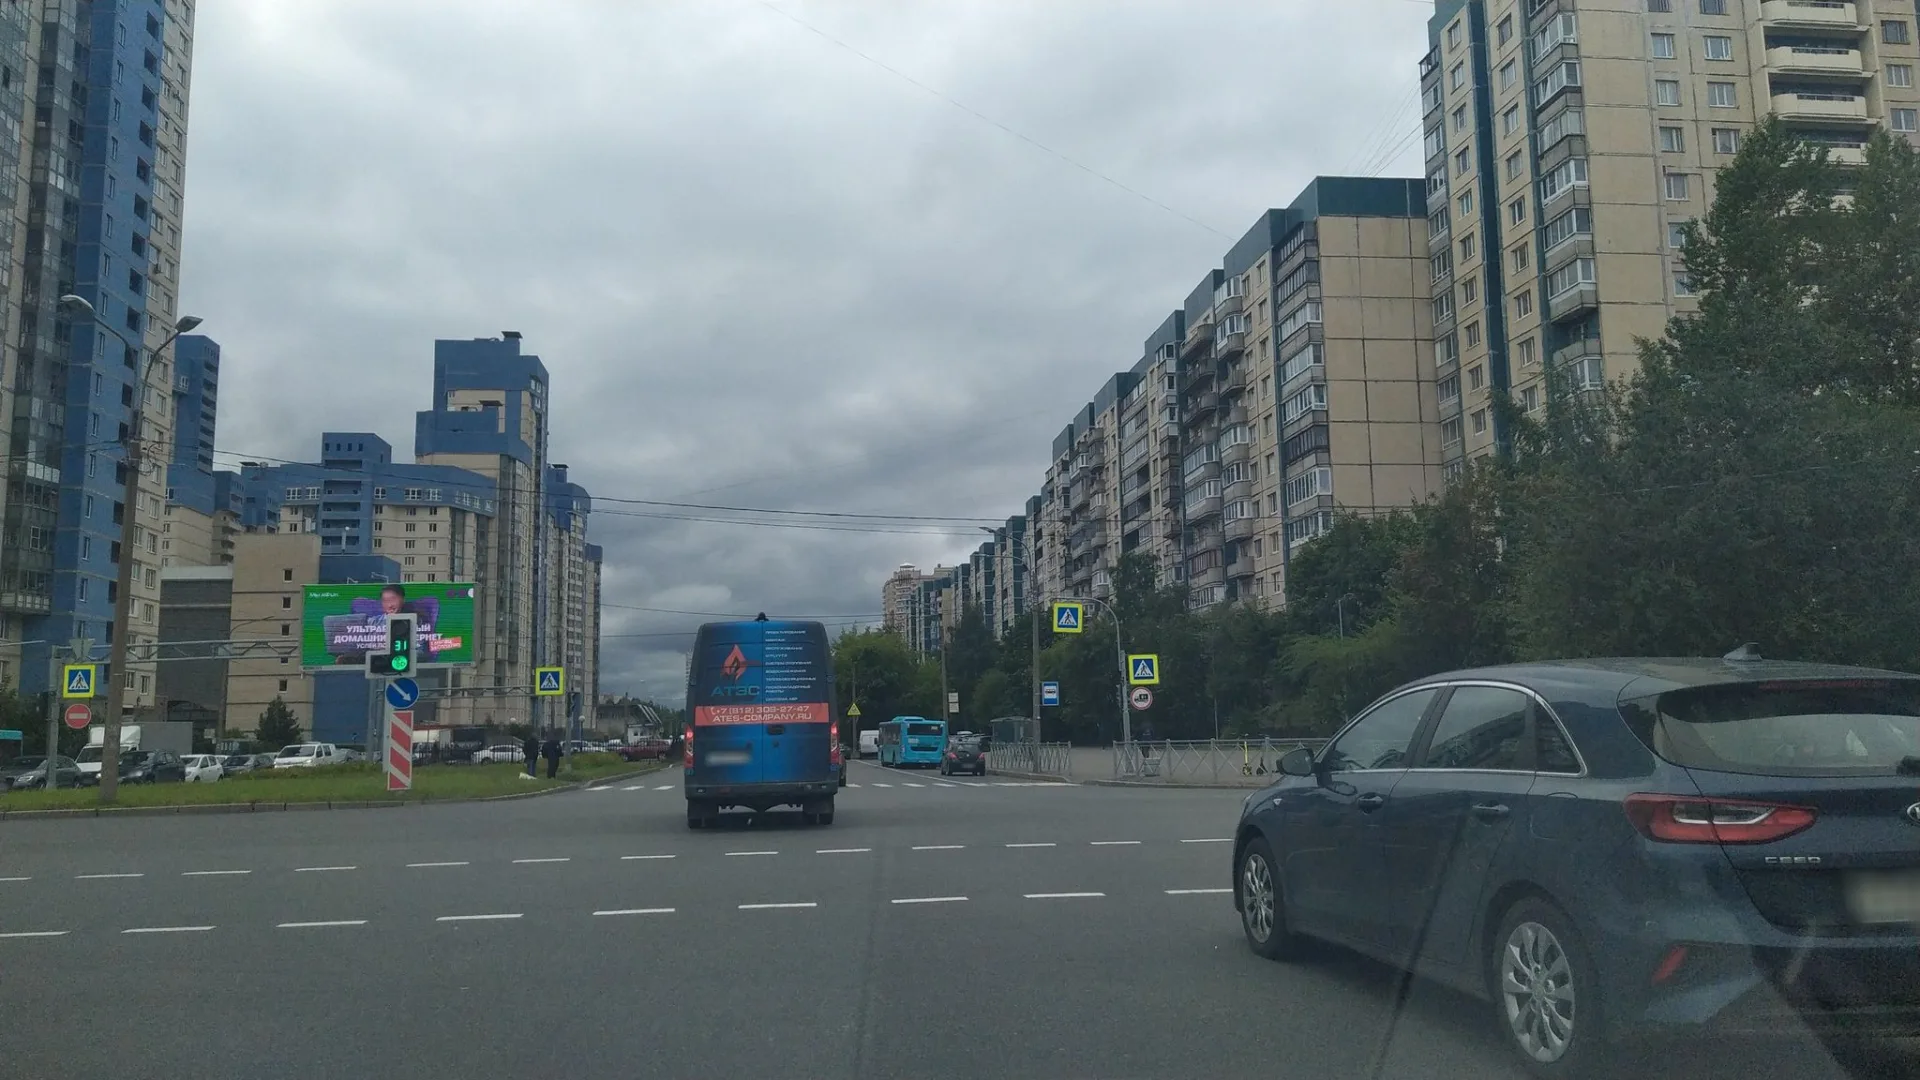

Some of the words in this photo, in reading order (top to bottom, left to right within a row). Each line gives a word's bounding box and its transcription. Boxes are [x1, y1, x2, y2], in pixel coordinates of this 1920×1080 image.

[334, 635, 387, 644] ДОМАШНИ
[395, 641, 407, 651] 31
[711, 685, 760, 696] АТЭС
[712, 713, 812, 722] ATES-COMPANY.RU
